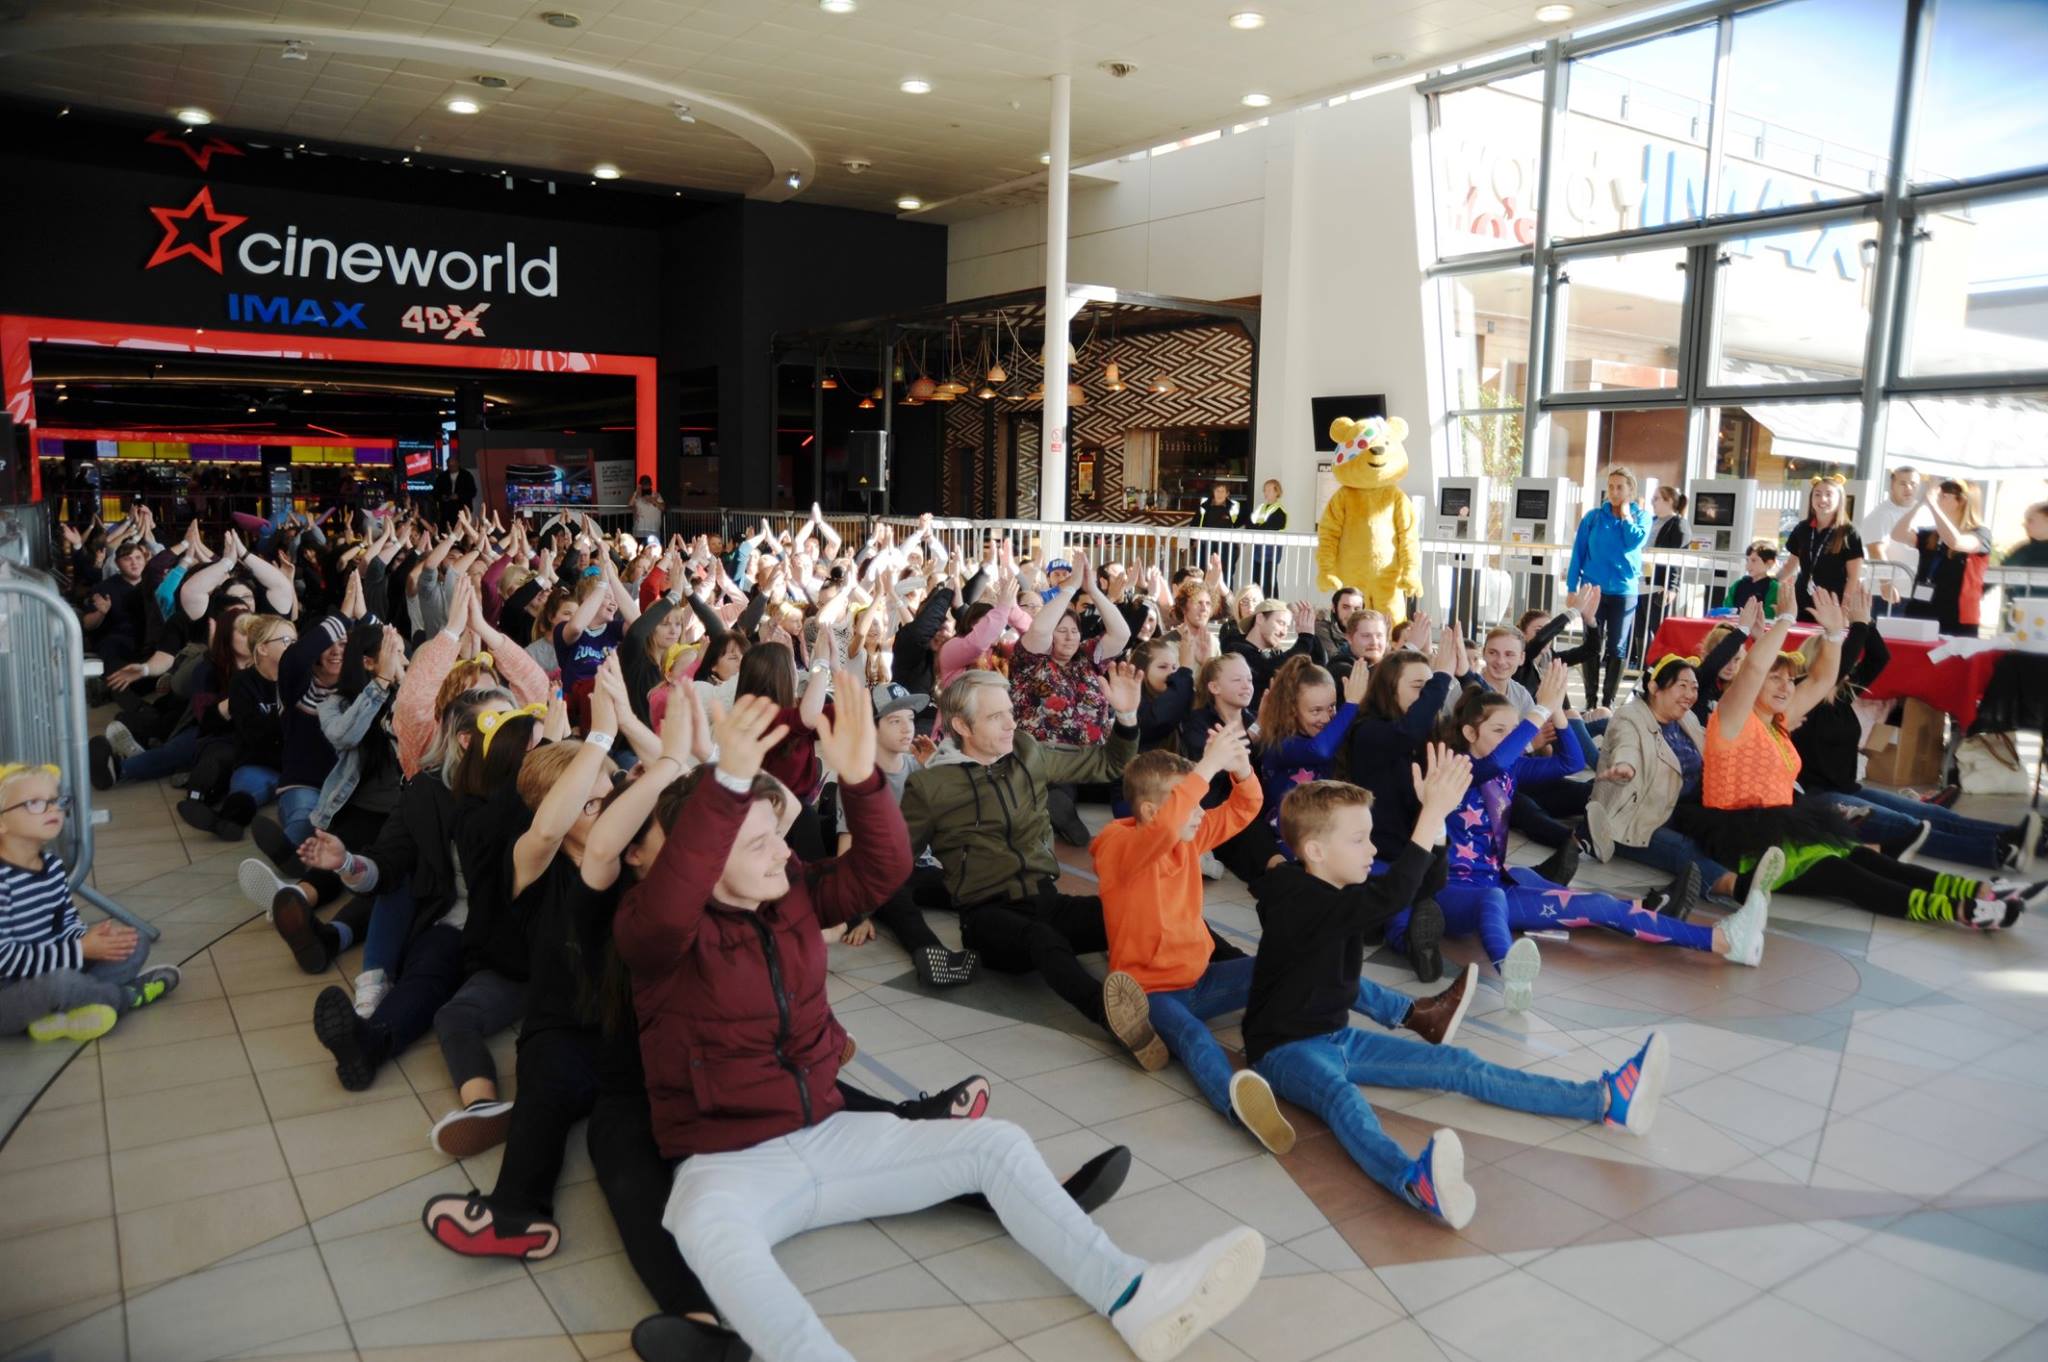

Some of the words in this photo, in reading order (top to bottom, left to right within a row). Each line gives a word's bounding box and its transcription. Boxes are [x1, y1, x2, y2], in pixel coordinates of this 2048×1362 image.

[238, 225, 558, 297] cineworld
[228, 293, 368, 329] IMAX
[401, 302, 491, 340] 4DX
